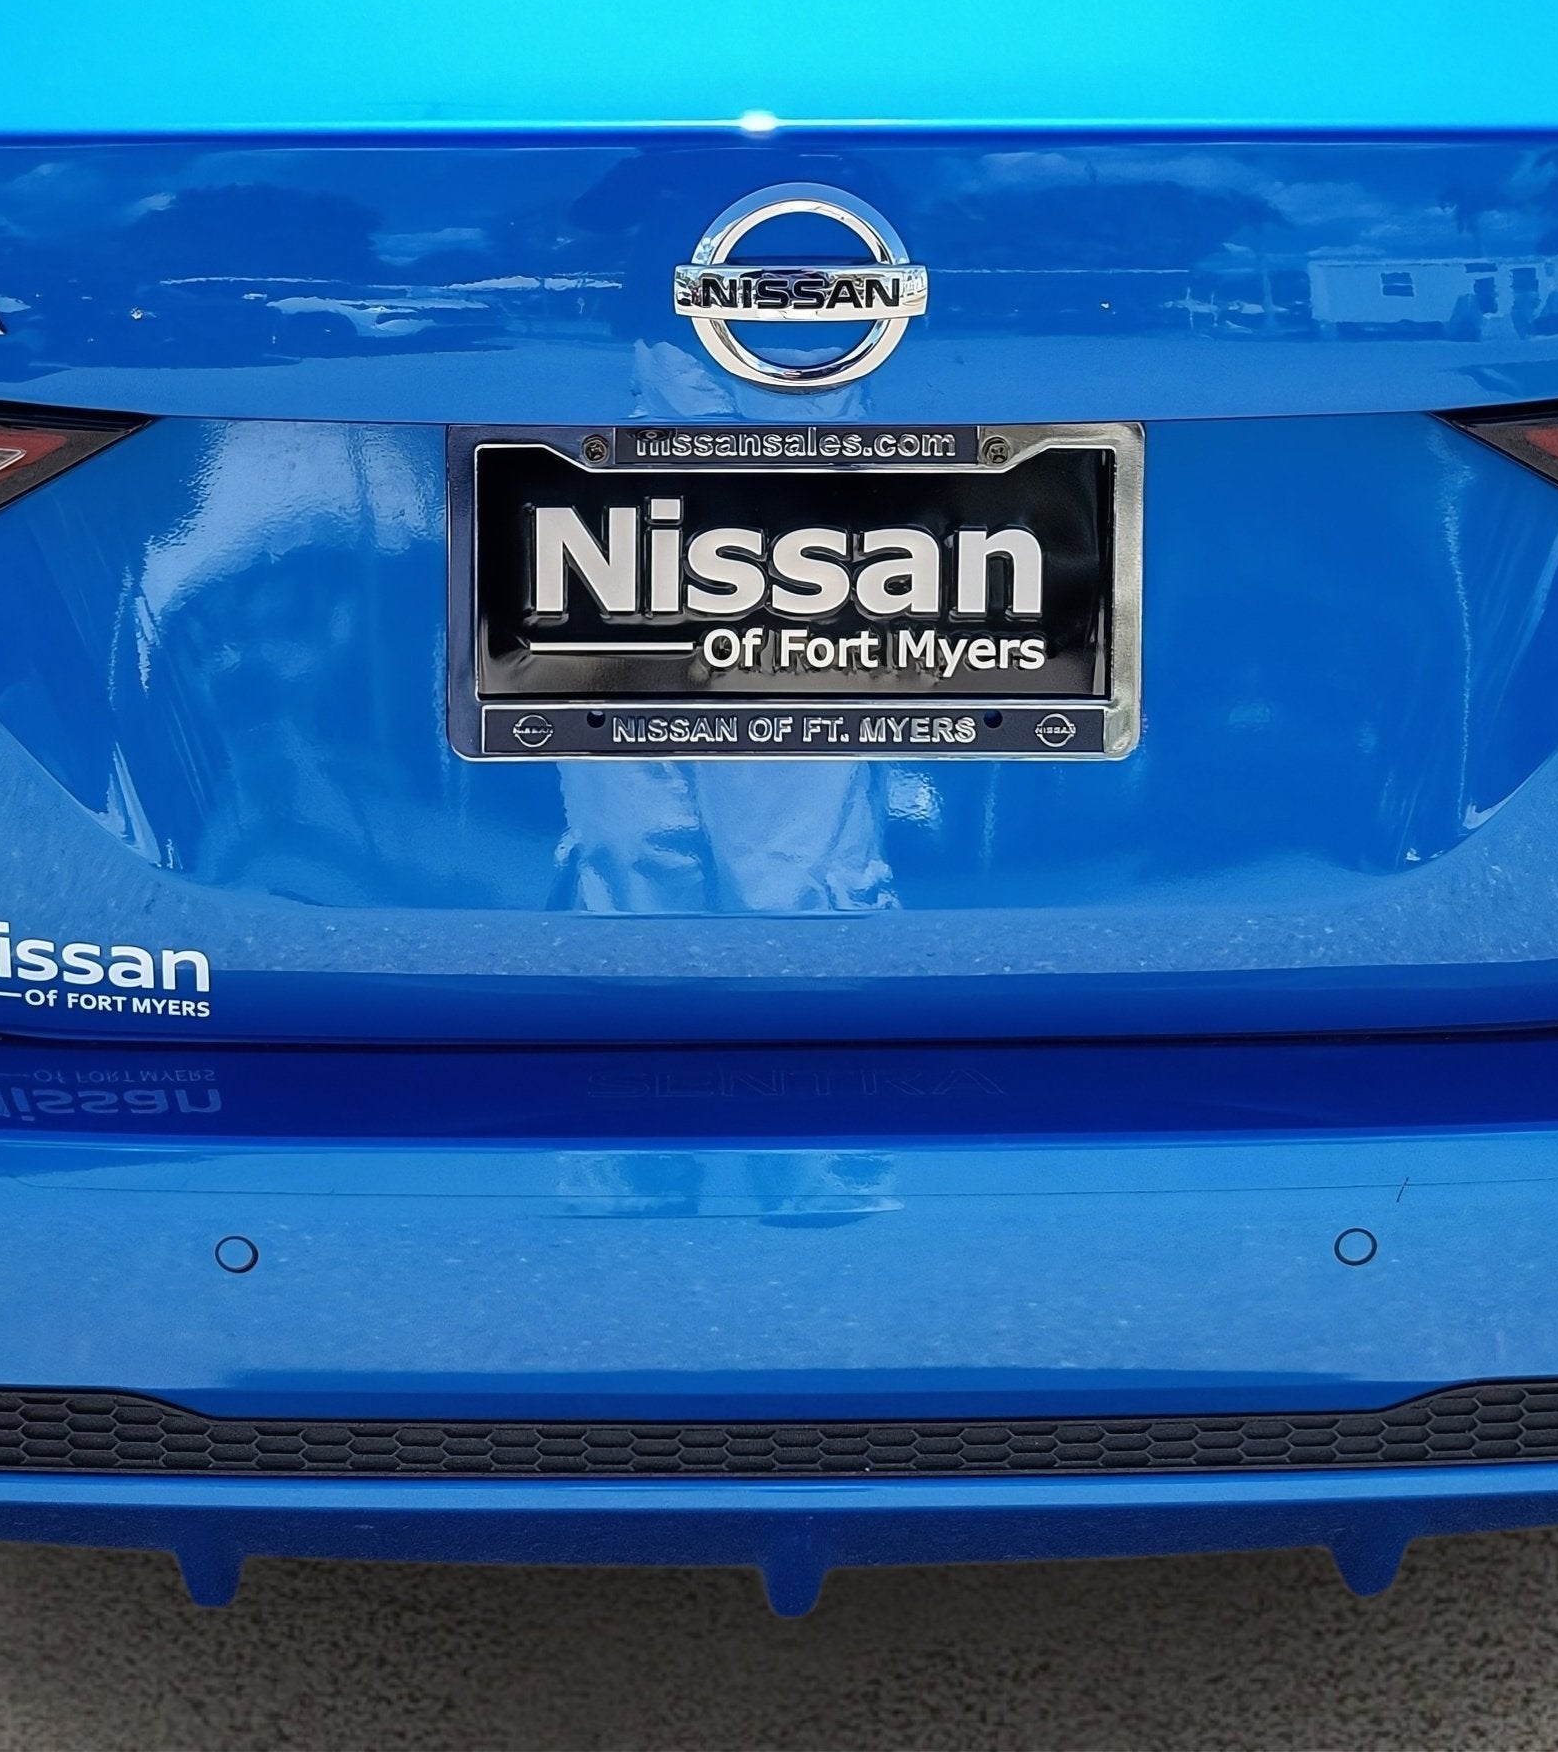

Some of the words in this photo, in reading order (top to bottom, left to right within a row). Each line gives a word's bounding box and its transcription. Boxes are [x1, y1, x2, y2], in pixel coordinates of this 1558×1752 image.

[701, 277, 900, 310] NISSAN
[534, 498, 1041, 615] Nissan
[703, 627, 763, 669] Of
[780, 629, 879, 669] Fort
[897, 629, 1046, 678] Myers
[612, 716, 738, 743] NISSAN
[748, 716, 793, 743] OF
[803, 716, 850, 743] FT.
[859, 716, 977, 744] MYERS
[67, 992, 127, 1012] FORT
[132, 998, 211, 1018] MYERS
